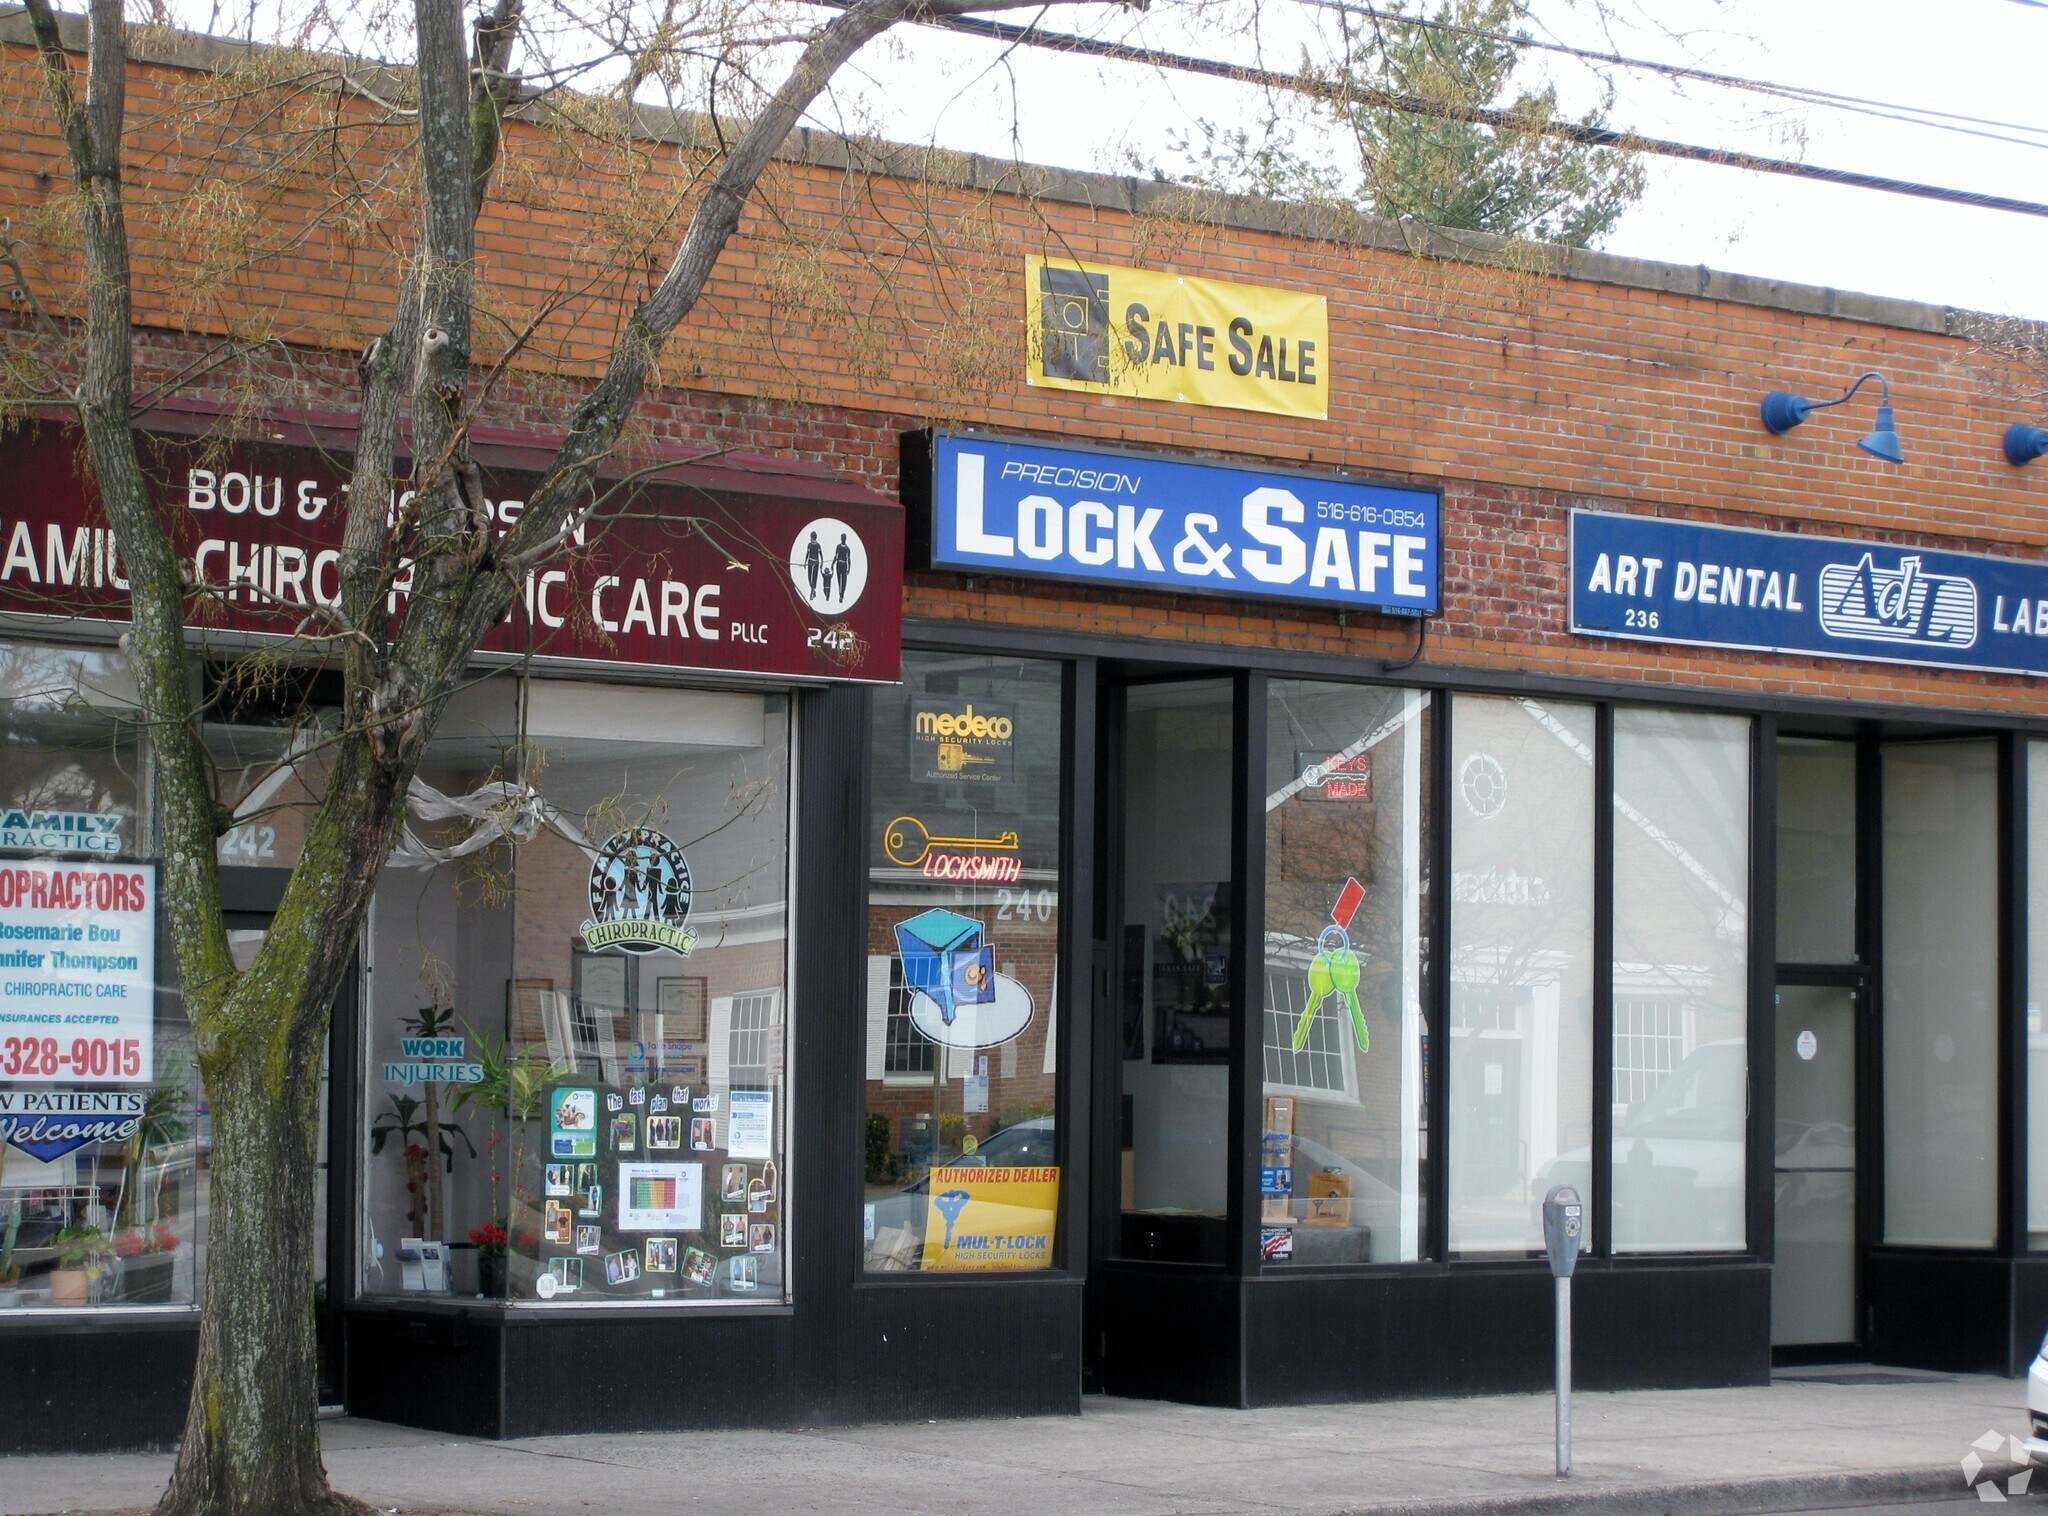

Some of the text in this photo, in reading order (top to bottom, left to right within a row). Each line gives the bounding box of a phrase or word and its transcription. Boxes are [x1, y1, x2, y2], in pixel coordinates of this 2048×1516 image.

[1124, 303, 1317, 385] SAFE SALE
[1001, 461, 1142, 494] PRECISION
[188, 469, 282, 517] BOU
[297, 480, 328, 520] &
[955, 452, 1427, 598] LOCK & SAFE
[1316, 501, 1426, 529] 516-616-0854
[0, 519, 131, 590] AMIL
[592, 574, 721, 641] CARE
[731, 622, 769, 645] PLLC
[1588, 552, 1664, 598] ART
[1673, 561, 1804, 613] DENTAL
[1624, 608, 1660, 630] 236
[806, 627, 853, 650] 242
[915, 704, 1013, 739] medeco
[939, 736, 983, 744] SECURITY
[986, 739, 1013, 747] LOCKS
[1325, 756, 1367, 771] KEYS
[926, 771, 1002, 782] Authorized Service Center
[1326, 782, 1368, 797] MADE
[0, 811, 119, 833] AMILY
[0, 831, 119, 851] RACTICE
[222, 824, 276, 858] 242
[641, 830, 690, 904] PRACTICE
[923, 852, 1022, 882] LOCKSMITH
[997, 888, 1052, 922] 240
[88, 924, 121, 942] Bou
[588, 922, 691, 951] CHIROPRACTIC
[50, 951, 138, 973] Thompson
[5, 982, 128, 998] CHIROPRACTIC CARE
[64, 1015, 119, 1025] ACCEPTED
[0, 1037, 141, 1076] -328-9015
[402, 1040, 464, 1057] WORK
[384, 1064, 483, 1085] INJURIES
[23, 1094, 142, 1111] PATIENTS
[608, 1095, 622, 1109] The
[651, 1096, 668, 1112] plan
[674, 1087, 689, 1101] that
[693, 1096, 719, 1110] works!
[936, 1168, 1057, 1184] AUTHORIZED DEALER
[957, 1236, 1047, 1249] MUL-T-LOCK
[955, 1251, 1046, 1260] HIGH-SECURITY LOCKS
